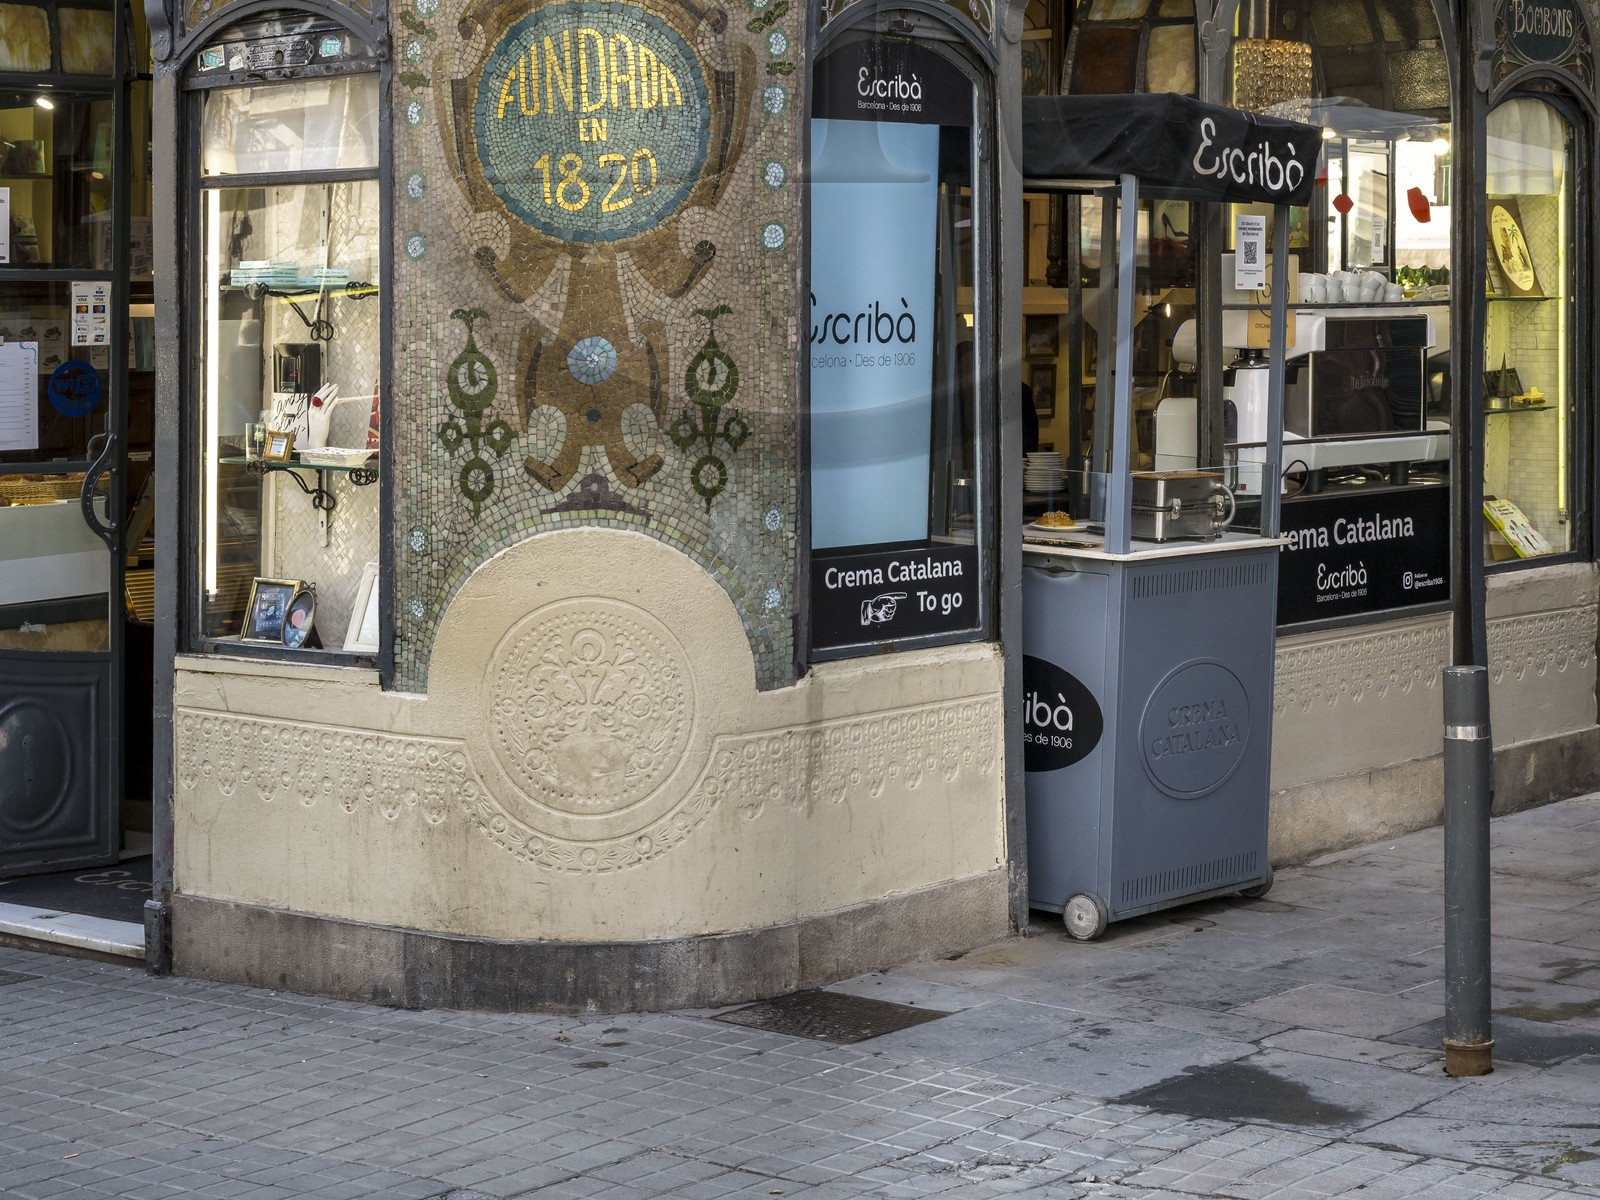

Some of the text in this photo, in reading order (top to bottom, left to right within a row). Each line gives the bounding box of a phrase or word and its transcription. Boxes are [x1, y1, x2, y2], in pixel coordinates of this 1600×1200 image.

[497, 27, 683, 119] FUNDADA
[857, 66, 922, 100] Escribà
[857, 100, 886, 110] Barcelona
[578, 118, 608, 142] EN
[532, 147, 658, 212] 1820
[855, 353, 875, 367] Des
[877, 352, 892, 367] de
[894, 352, 916, 366] 1906
[1333, 513, 1415, 546] Catalana
[824, 556, 963, 590] Crema Catalana
[1316, 560, 1368, 591] Escribà
[916, 590, 963, 615] To go
[1167, 699, 1229, 730] CREMA
[1035, 732, 1049, 745] de
[1051, 735, 1073, 749] 1906
[1151, 723, 1242, 760] CATALANA
